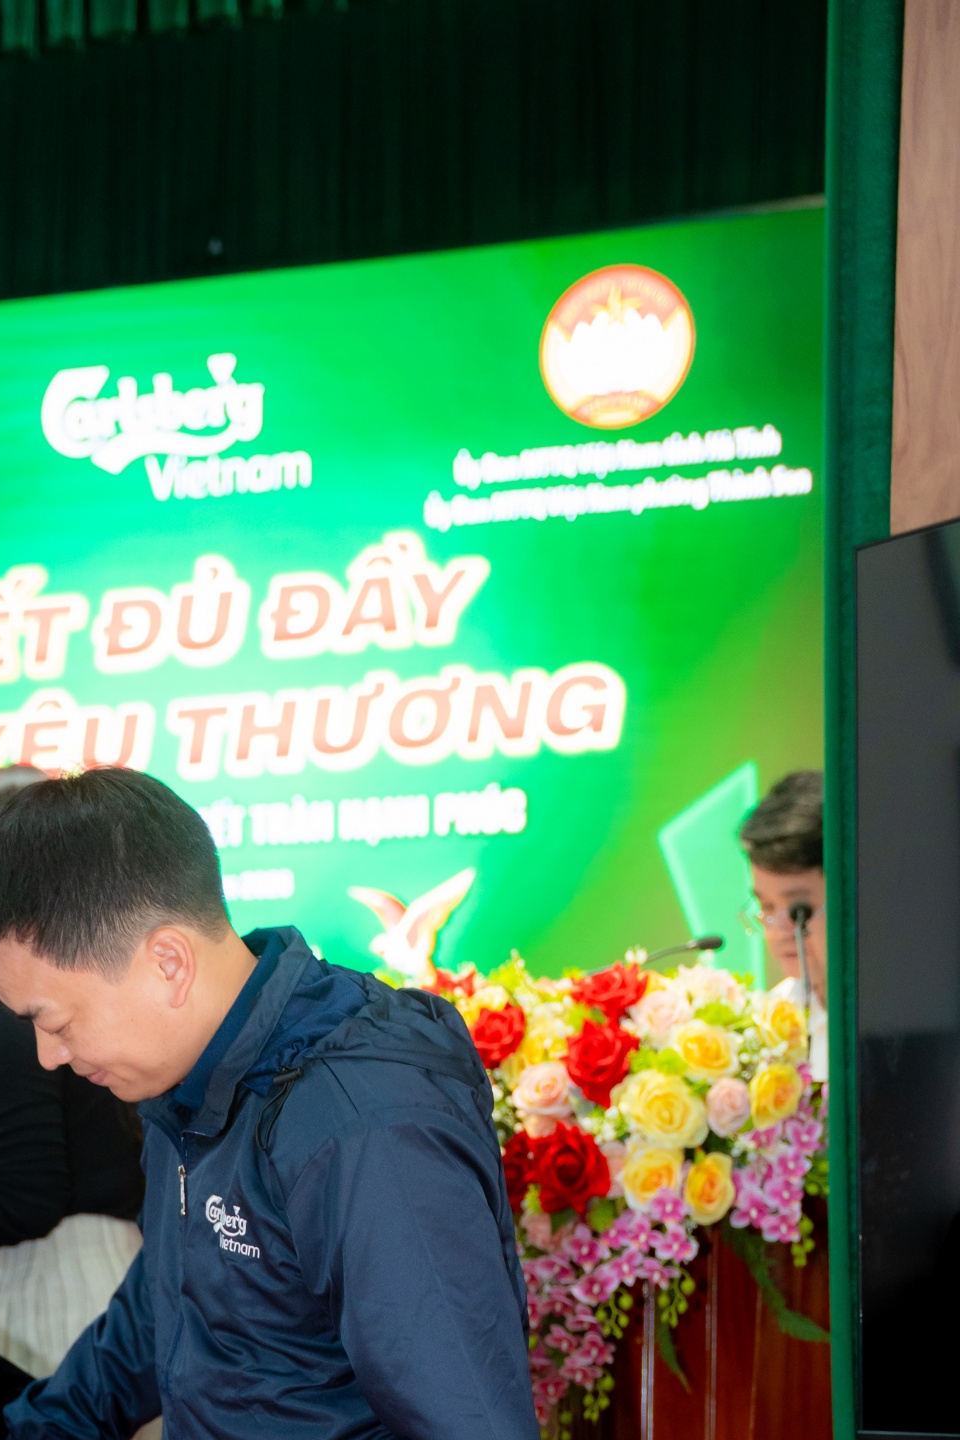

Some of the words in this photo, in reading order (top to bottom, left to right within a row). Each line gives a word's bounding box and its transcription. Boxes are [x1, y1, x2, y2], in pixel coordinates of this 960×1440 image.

[41, 353, 265, 474] Carlsberg
[144, 451, 312, 502] Vietnam
[98, 560, 240, 665] ĐỦ
[265, 537, 477, 652] ĐẦY
[172, 668, 617, 773] THƯƠNG
